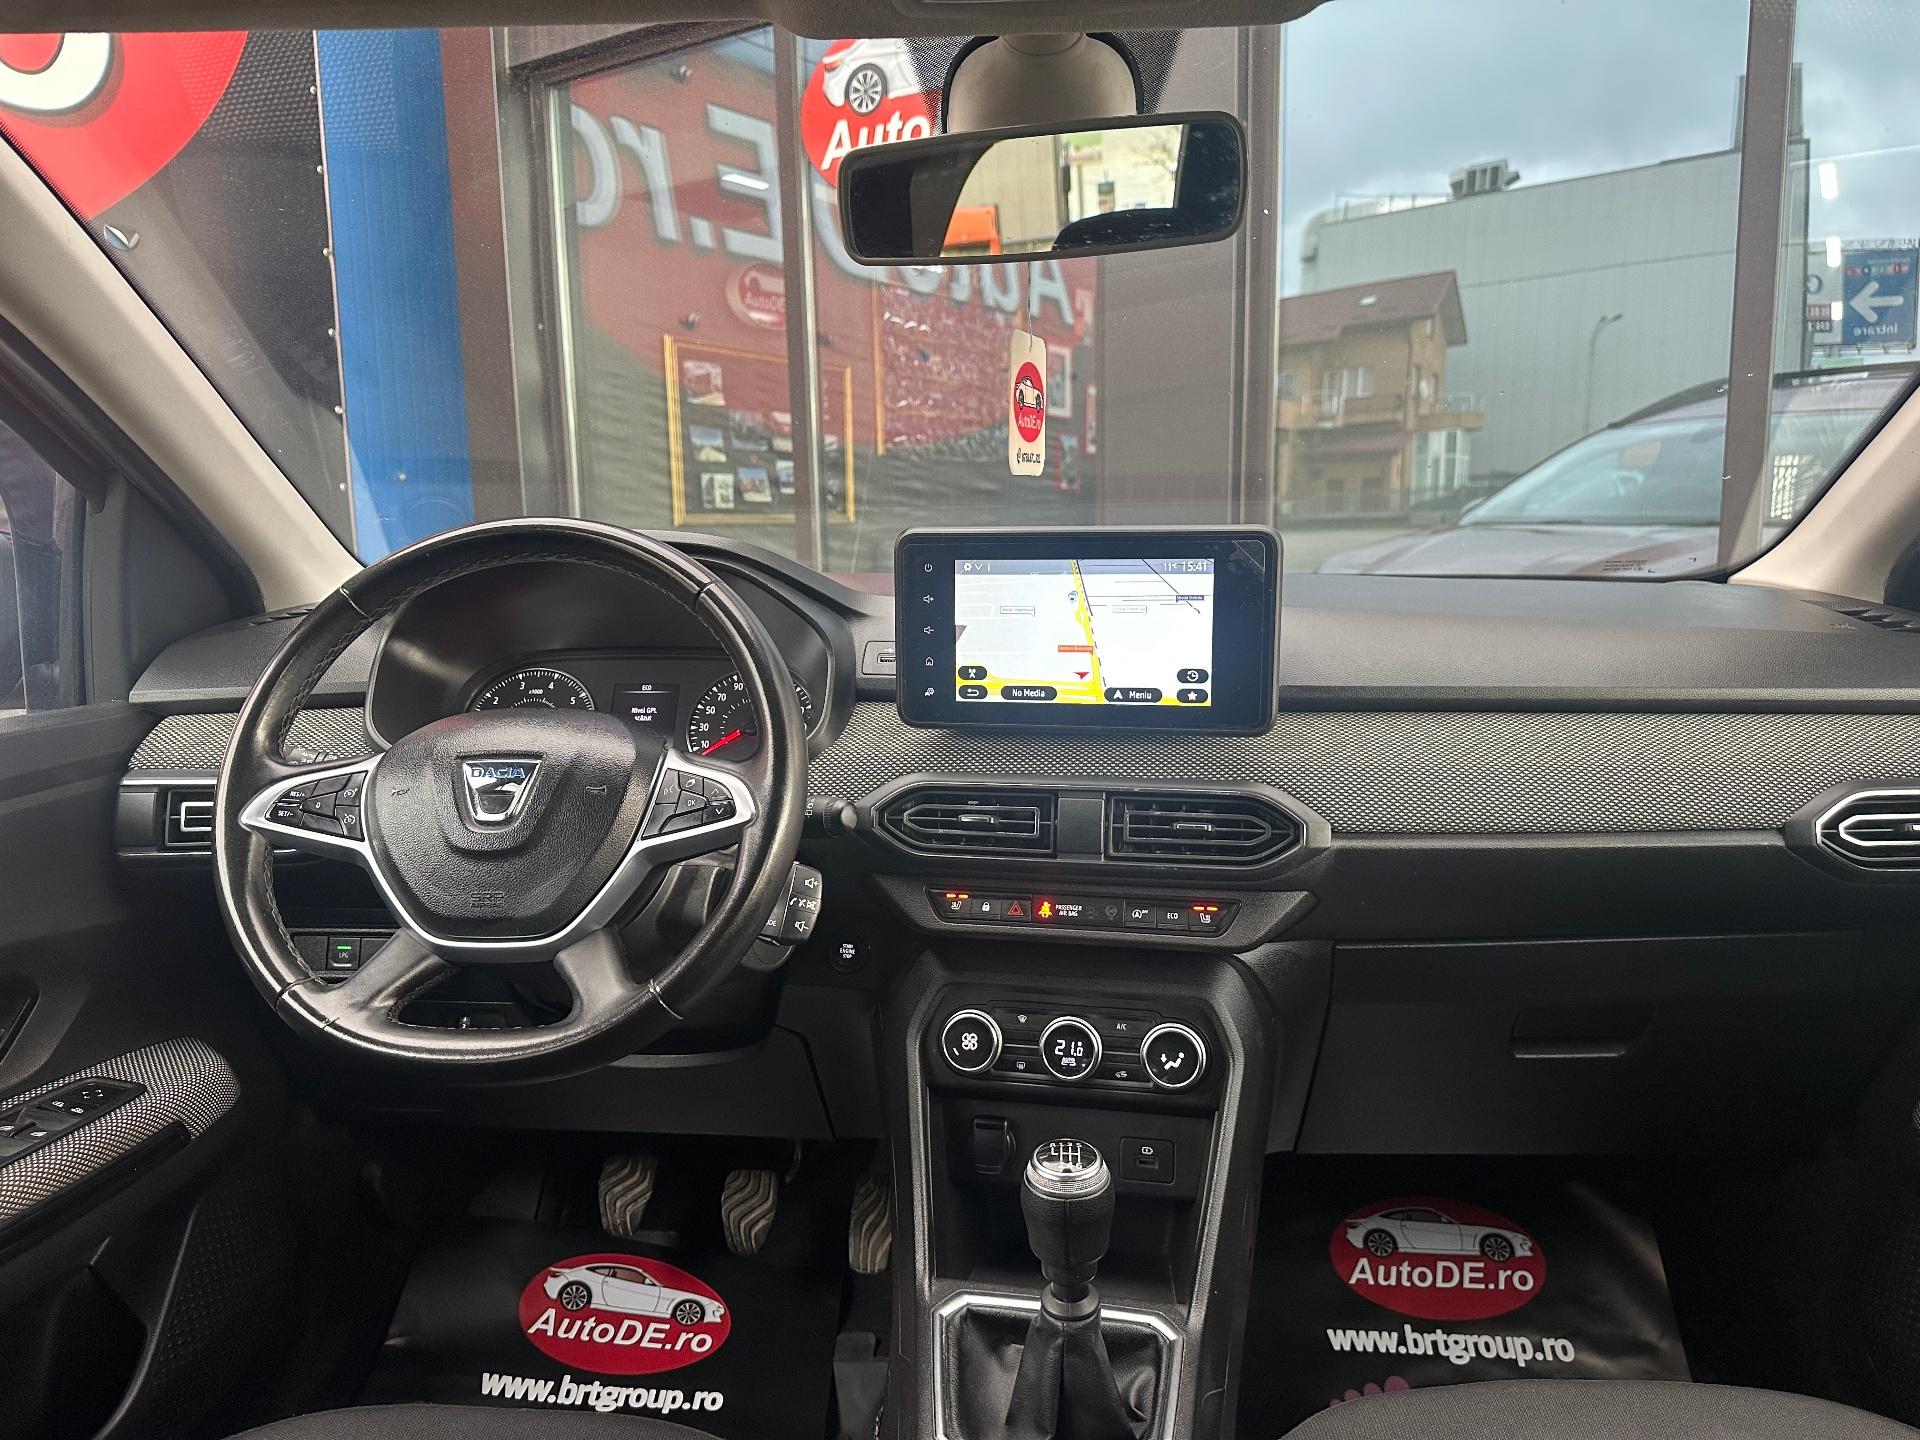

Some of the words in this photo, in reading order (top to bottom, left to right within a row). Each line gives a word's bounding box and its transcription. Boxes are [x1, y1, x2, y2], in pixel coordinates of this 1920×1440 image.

[1181, 561, 1207, 572] 15:41
[519, 681, 526, 690] 3
[548, 681, 555, 690] 4
[733, 682, 744, 691] 90
[717, 693, 727, 701] 70
[1012, 688, 1023, 697] No
[1023, 688, 1045, 698] Media
[1129, 690, 1152, 699] Meniu
[493, 696, 500, 705] 2
[569, 696, 576, 705] 5
[705, 706, 716, 715] 50
[698, 723, 709, 732] 30
[700, 740, 710, 749] 10
[471, 767, 526, 779] DACIA
[687, 799, 696, 807] OK
[1116, 1022, 1127, 1031] A/C
[1349, 1257, 1535, 1291] AutoDE.ro
[527, 1307, 714, 1353] AutoDE.ro
[1326, 1323, 1576, 1367] www.brtgroup.ro
[480, 1371, 724, 1414] www.brtgroup.ro
